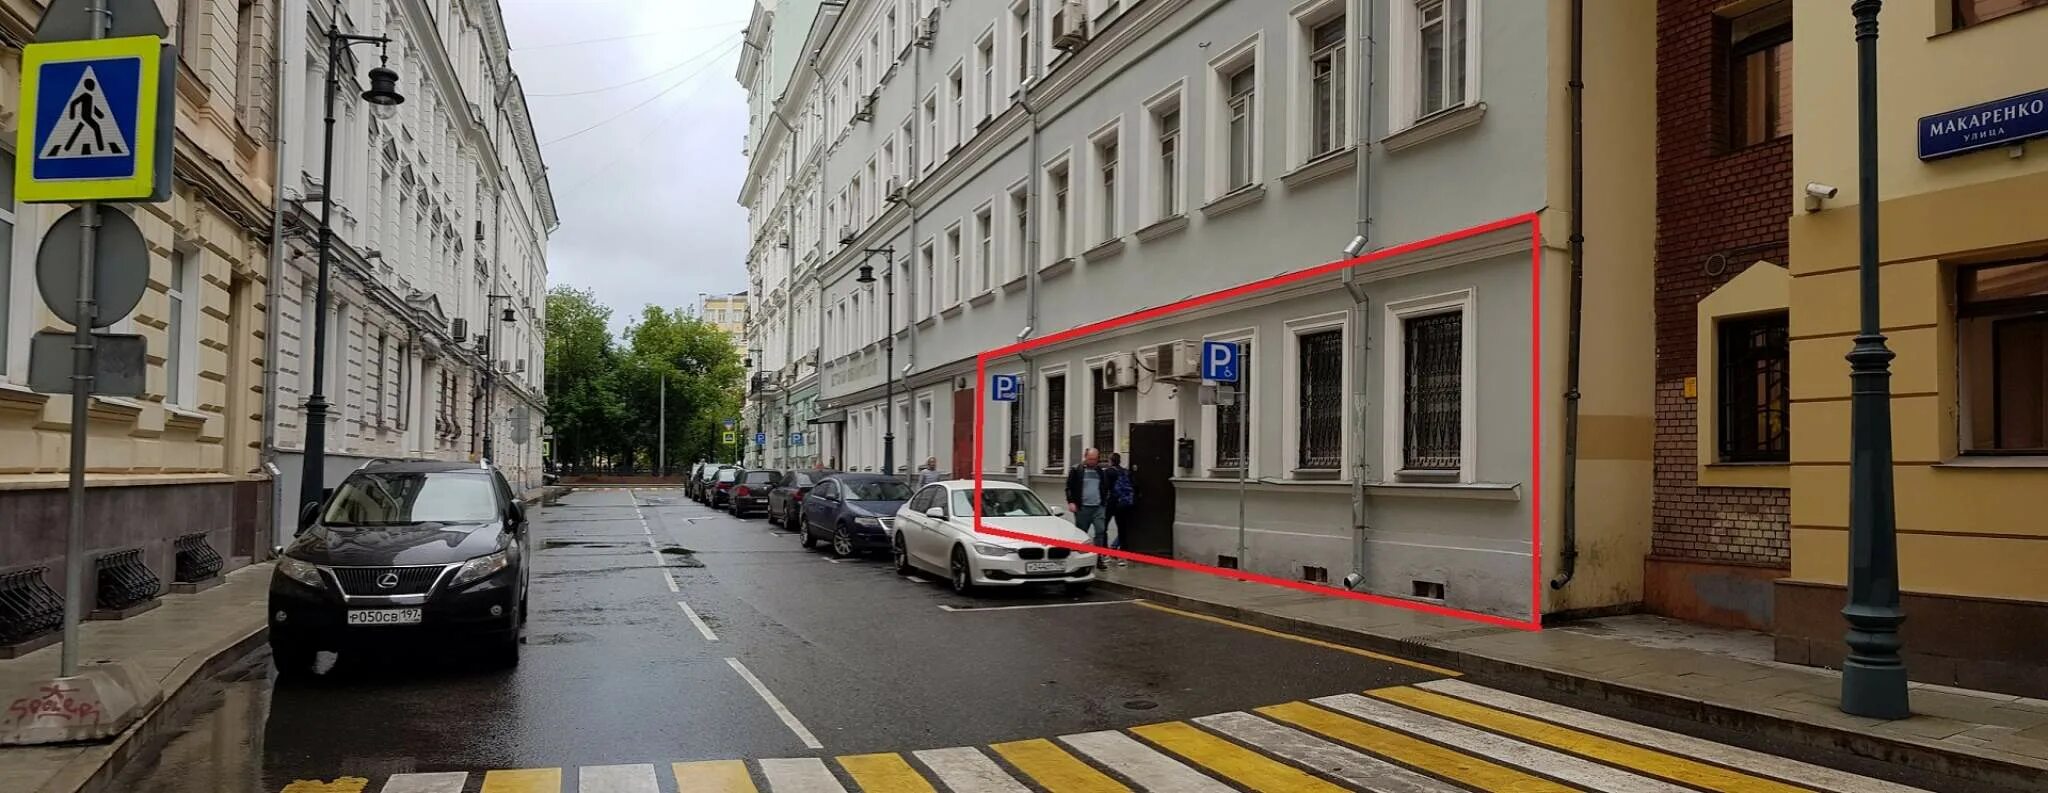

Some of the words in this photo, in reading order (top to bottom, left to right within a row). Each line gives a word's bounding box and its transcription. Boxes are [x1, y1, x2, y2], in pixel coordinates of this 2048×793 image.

[1930, 99, 2044, 137] МАКАРЕНКО
[1963, 127, 2005, 142] УЛИЦА
[1210, 343, 1231, 377] P
[997, 376, 1013, 399] P
